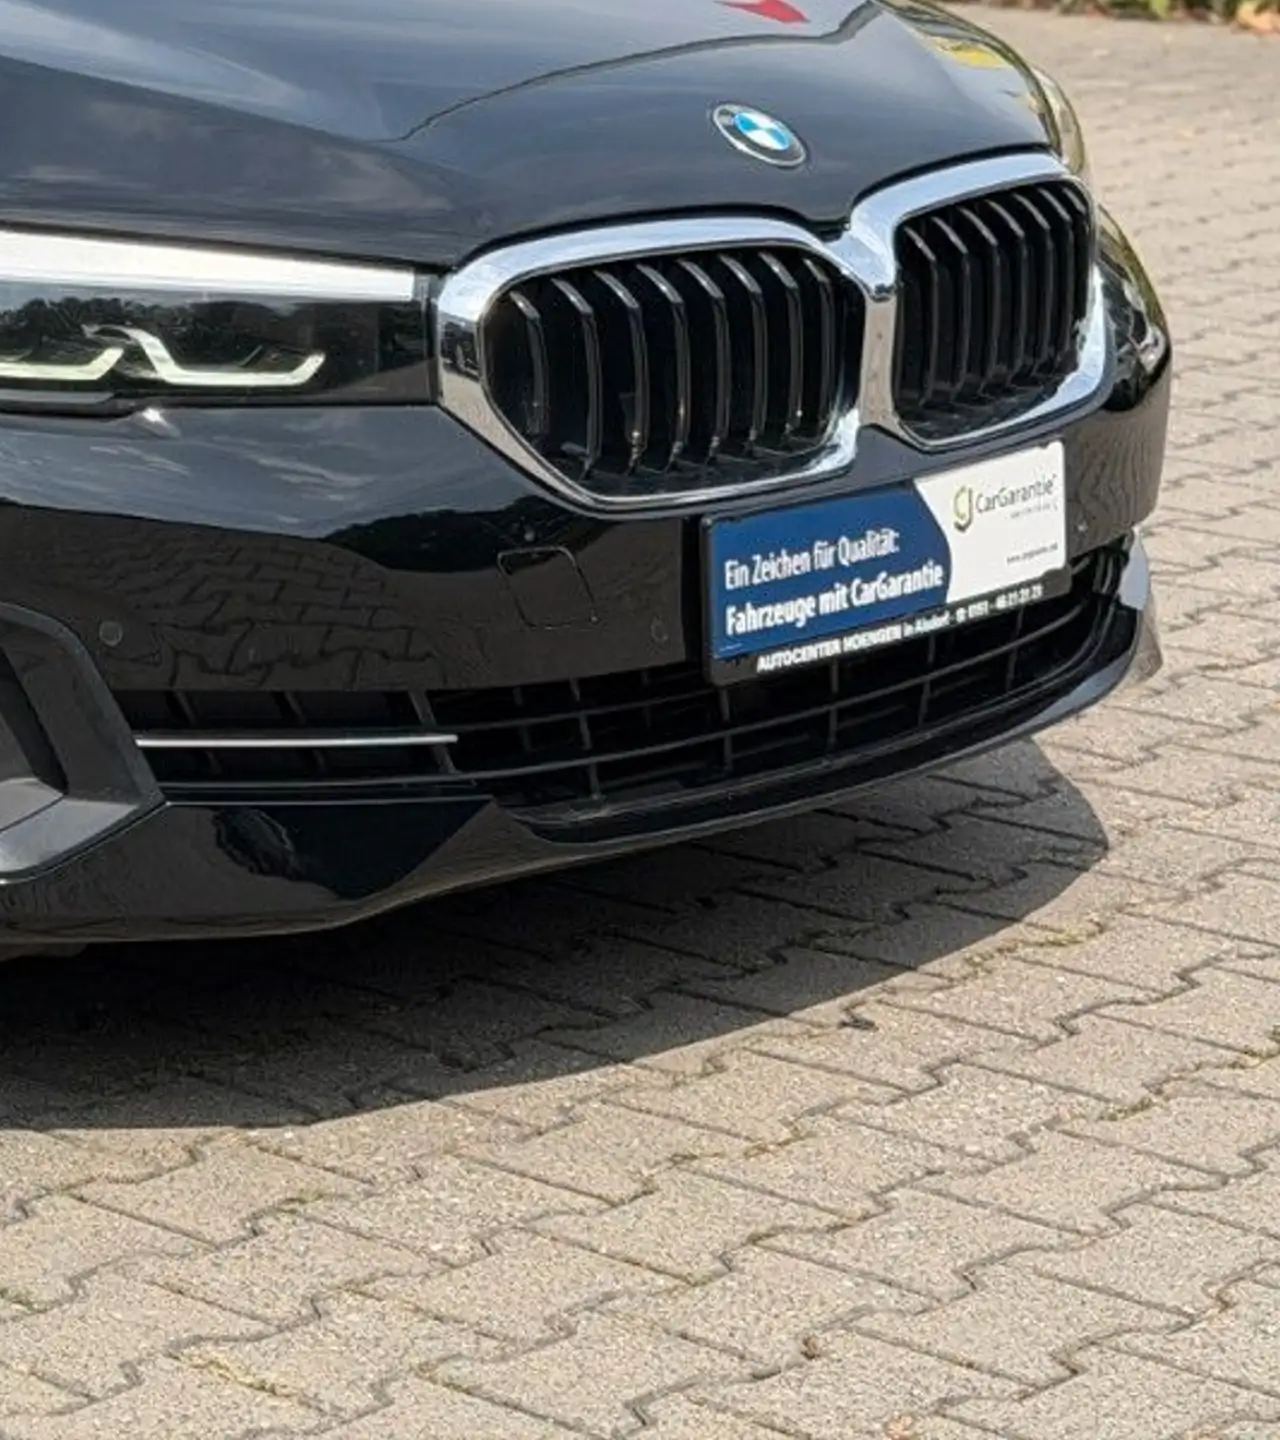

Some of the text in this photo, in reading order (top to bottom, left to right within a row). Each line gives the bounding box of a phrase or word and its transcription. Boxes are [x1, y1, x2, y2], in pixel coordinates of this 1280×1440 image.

[724, 528, 900, 590] Ein Zeichen für Qualität:
[726, 559, 943, 636] Fahrzeuge mit CarGarantie
[756, 638, 841, 673] AUTOCENTER
